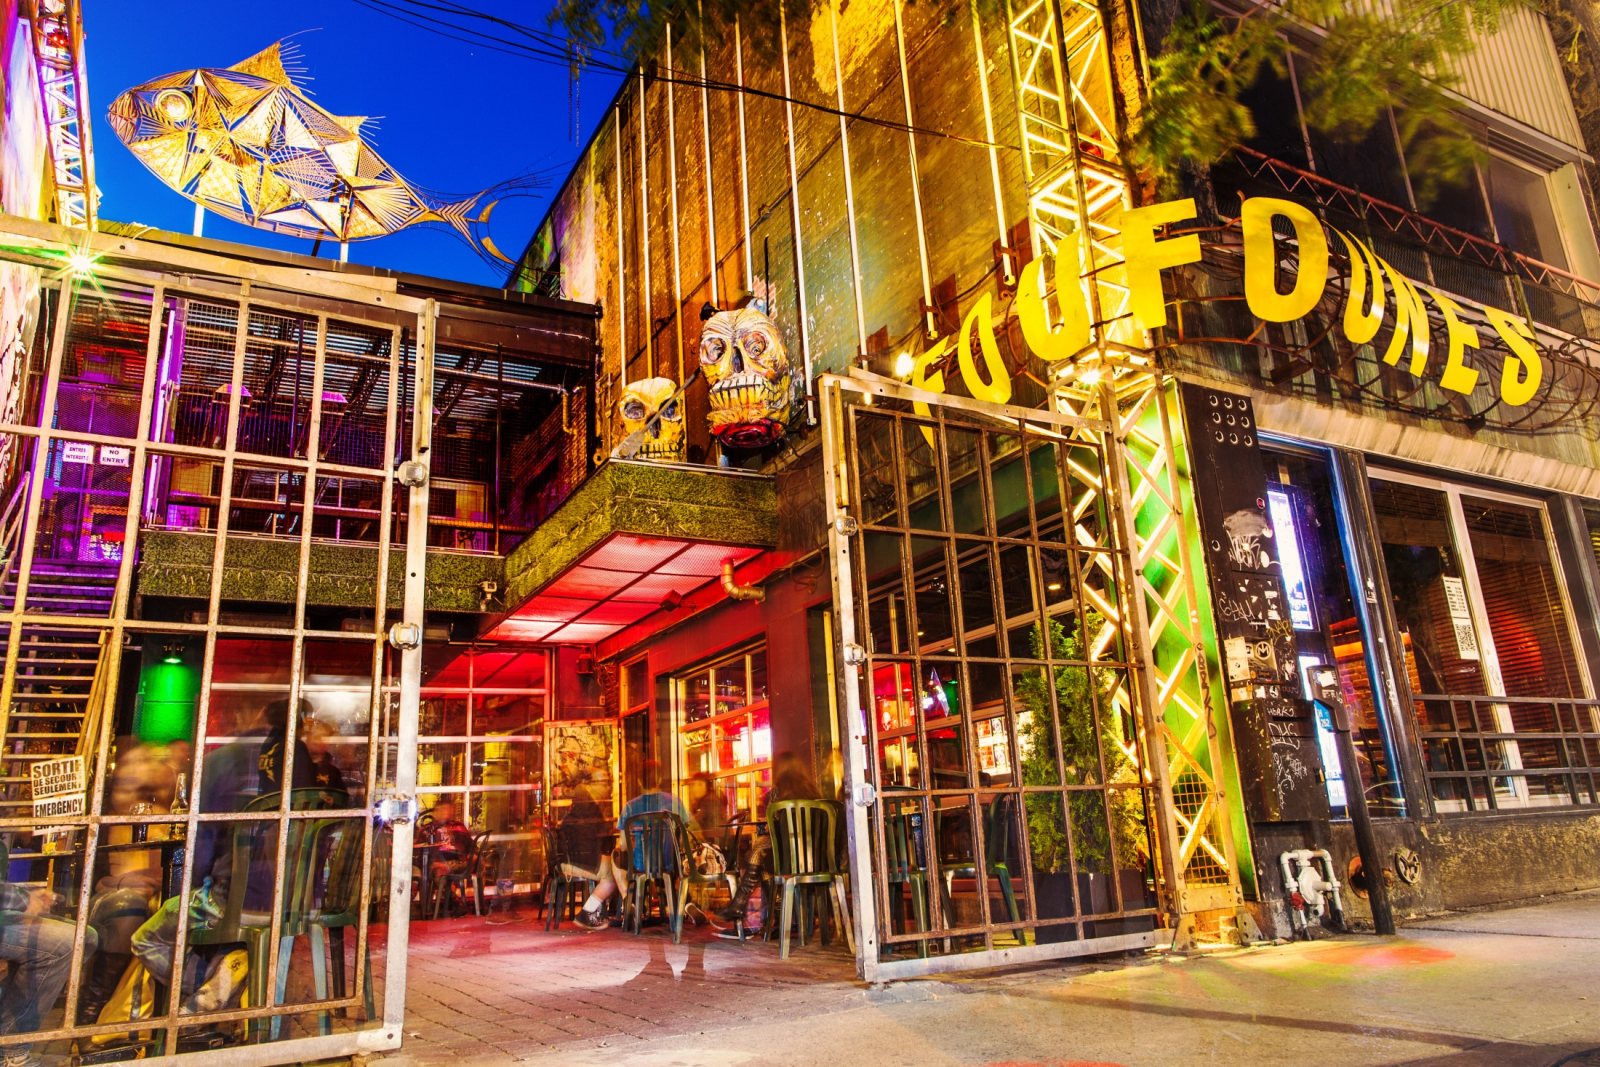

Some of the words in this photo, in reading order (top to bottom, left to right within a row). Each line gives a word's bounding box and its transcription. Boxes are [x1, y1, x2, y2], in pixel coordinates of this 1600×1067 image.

[102, 456, 125, 464] ENTRY
[33, 779, 44, 787] DE
[45, 773, 80, 785] SECOUR
[35, 799, 83, 817] EMERGENCY
